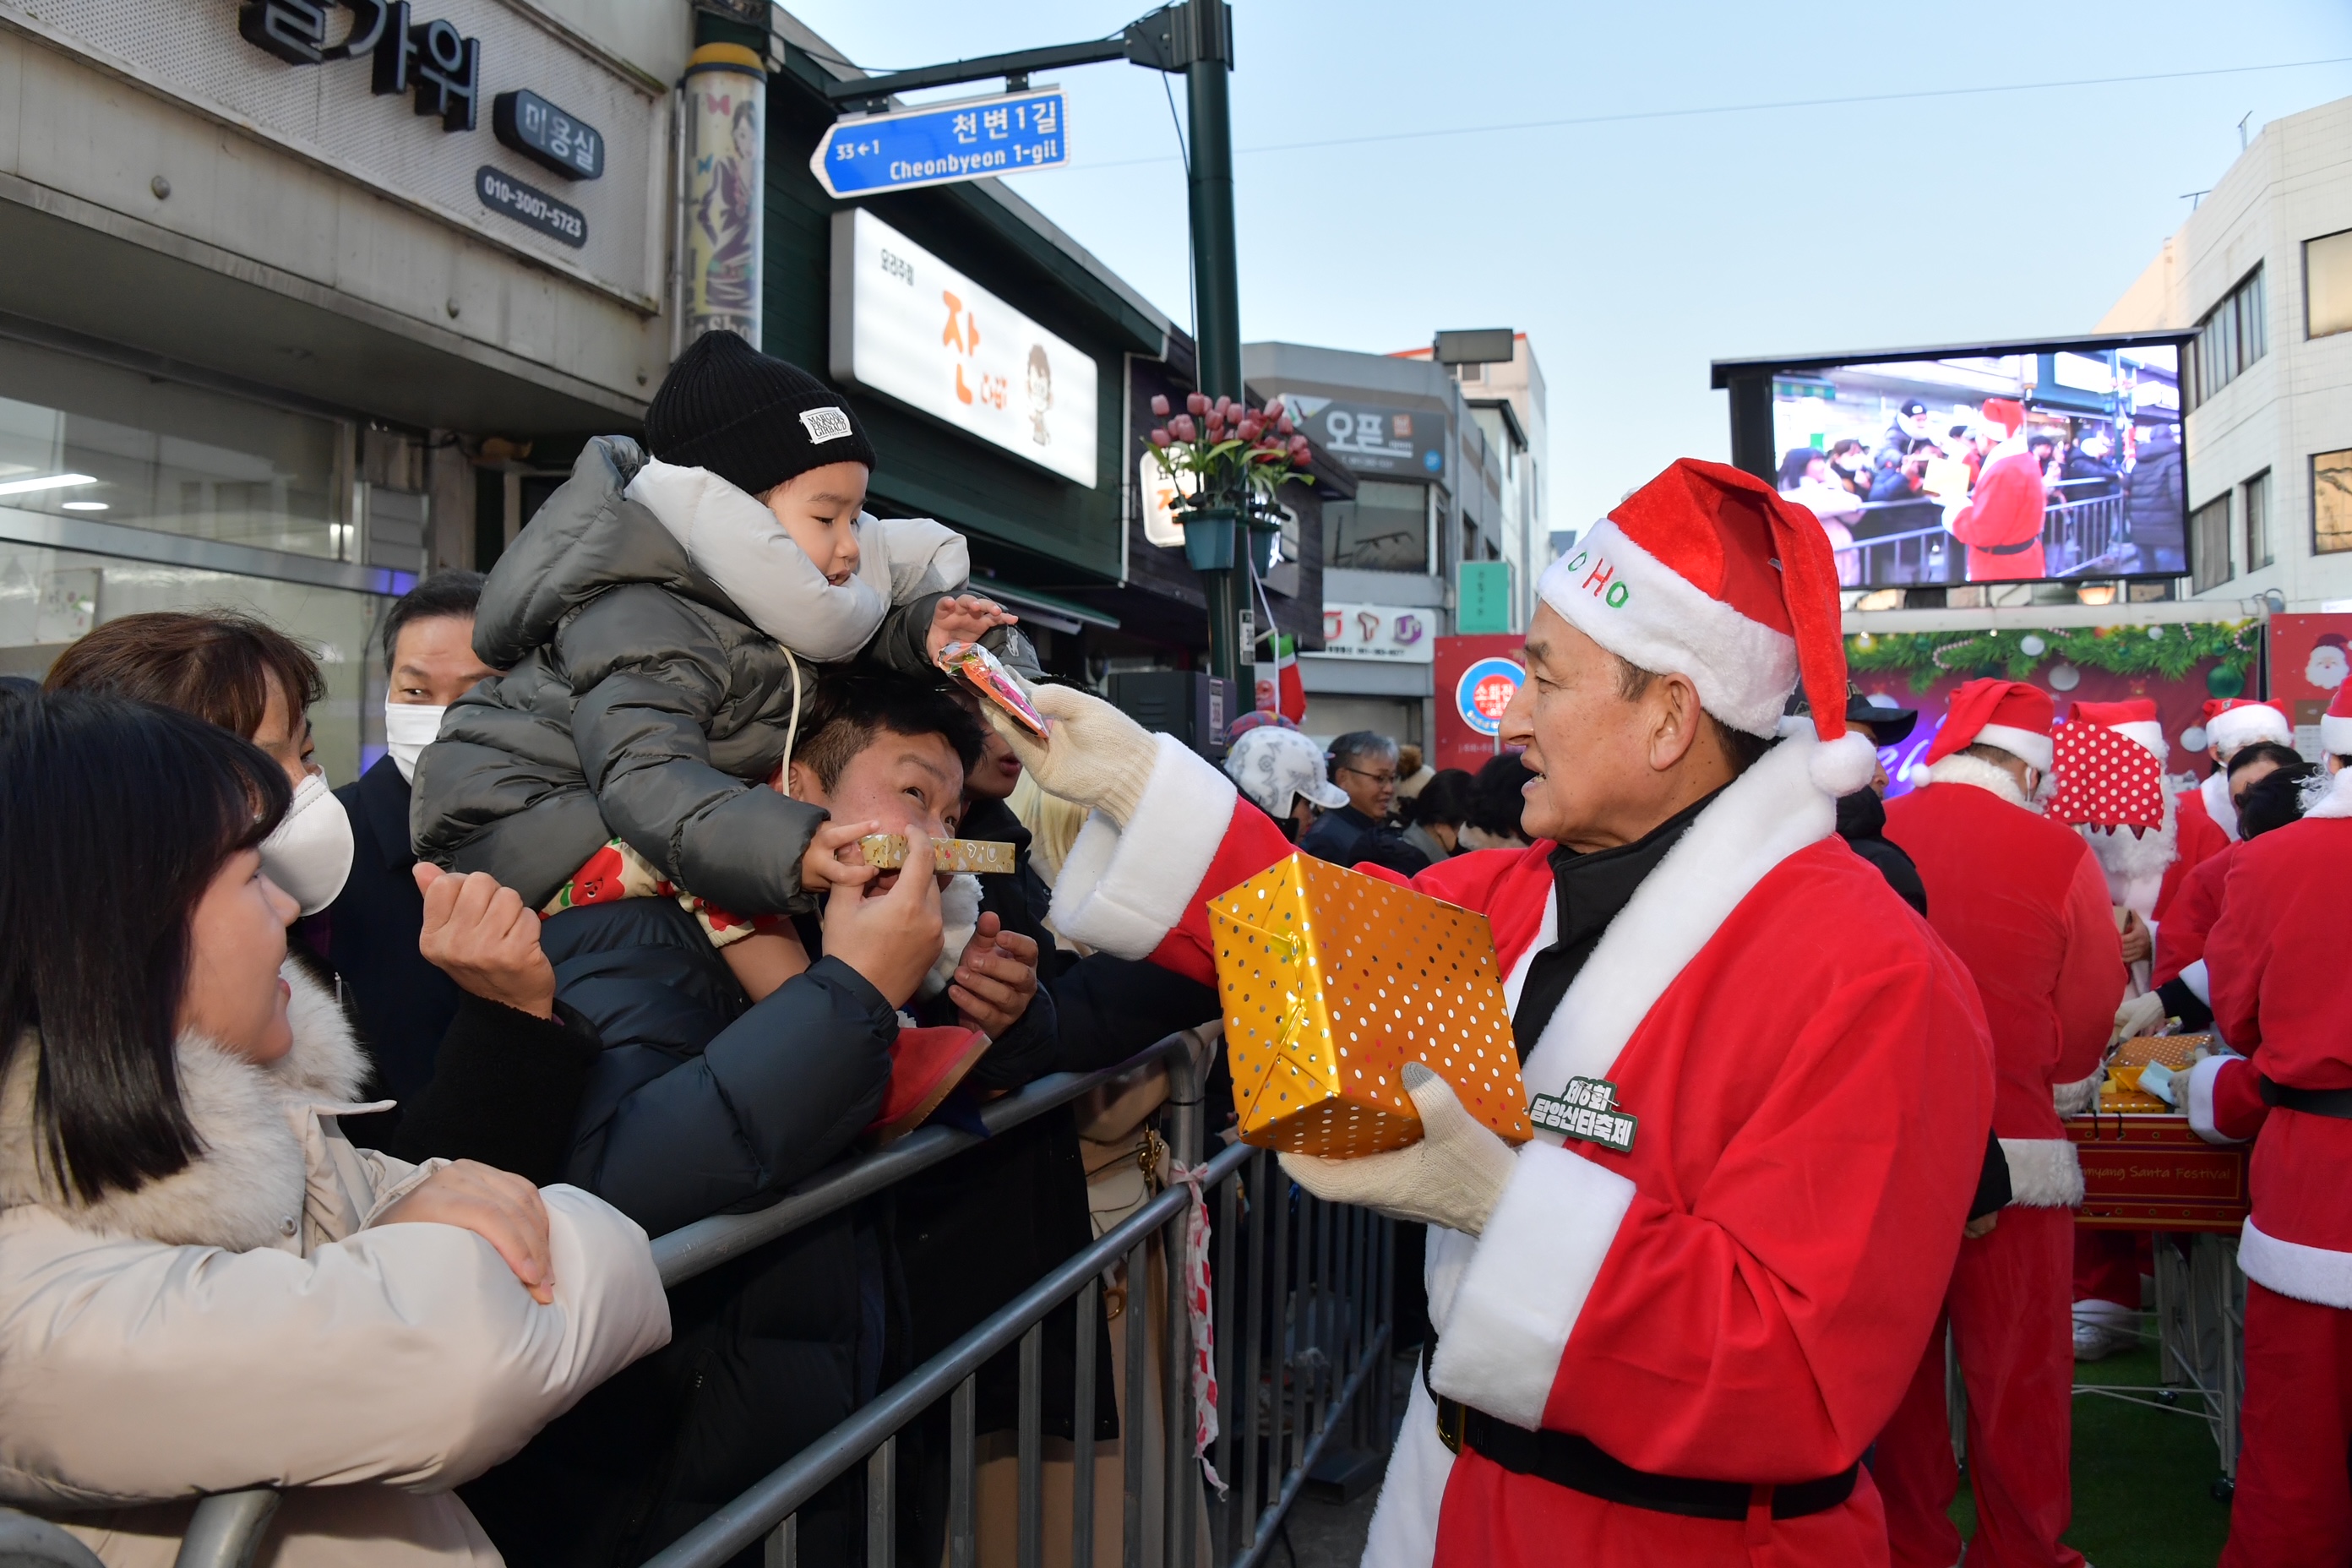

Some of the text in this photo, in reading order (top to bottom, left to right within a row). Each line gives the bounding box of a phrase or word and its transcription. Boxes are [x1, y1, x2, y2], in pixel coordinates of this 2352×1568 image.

[525, 102, 594, 172] 미용실
[952, 101, 1057, 144] 천변1길
[890, 139, 1058, 180] Cheonbyeon 1-gil
[484, 175, 583, 239] 010-3007-5723
[814, 422, 847, 437] GIRBAUD
[1326, 410, 1413, 458] 오픈
[1563, 1080, 1612, 1112] 제6회
[1530, 1097, 1633, 1146] 담양산타축제
[2129, 1165, 2170, 1179] Santa
[2175, 1168, 2230, 1180] Festival
